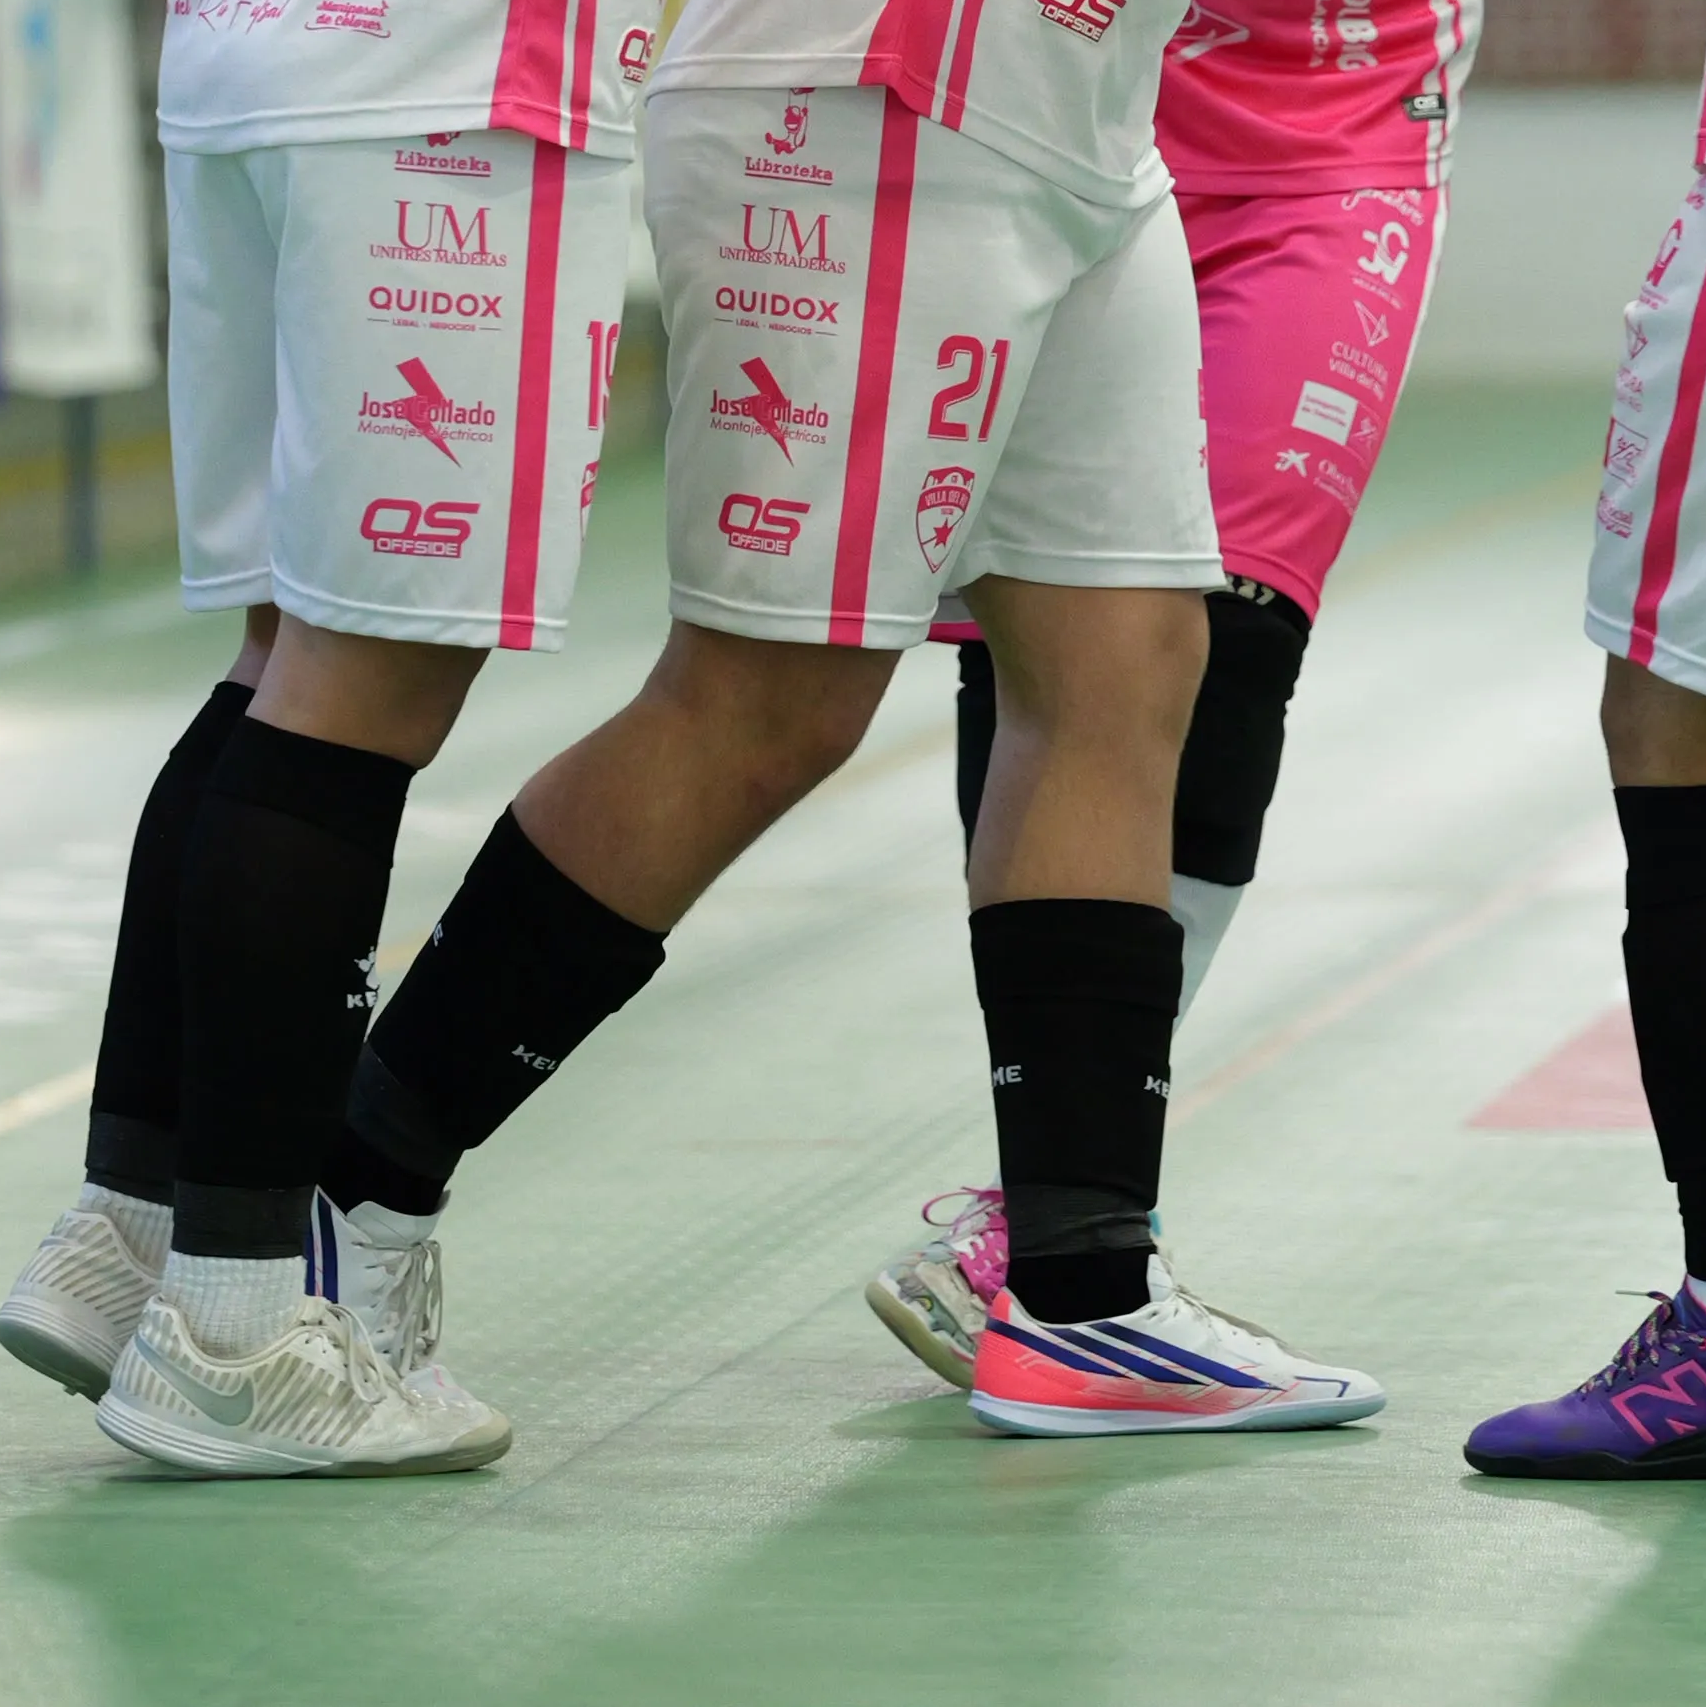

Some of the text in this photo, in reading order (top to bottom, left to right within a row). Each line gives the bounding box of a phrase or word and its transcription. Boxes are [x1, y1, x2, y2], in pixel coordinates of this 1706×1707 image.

[1044, 4, 1104, 43] OFFSIDE
[395, 150, 491, 173] Libroteka
[745, 156, 834, 182] Libroteka
[394, 199, 491, 256] UM
[741, 203, 831, 261] UM
[434, 249, 507, 268] MADERAS
[774, 252, 846, 275] MADERAS
[369, 286, 503, 319] QUIDOX
[715, 287, 840, 324] QUIDOX
[927, 334, 1011, 443] 21
[357, 420, 423, 441] Montajes
[710, 416, 770, 438] Montajes
[376, 536, 460, 557] OFFSIDE
[730, 532, 789, 556] OFFSIDE
